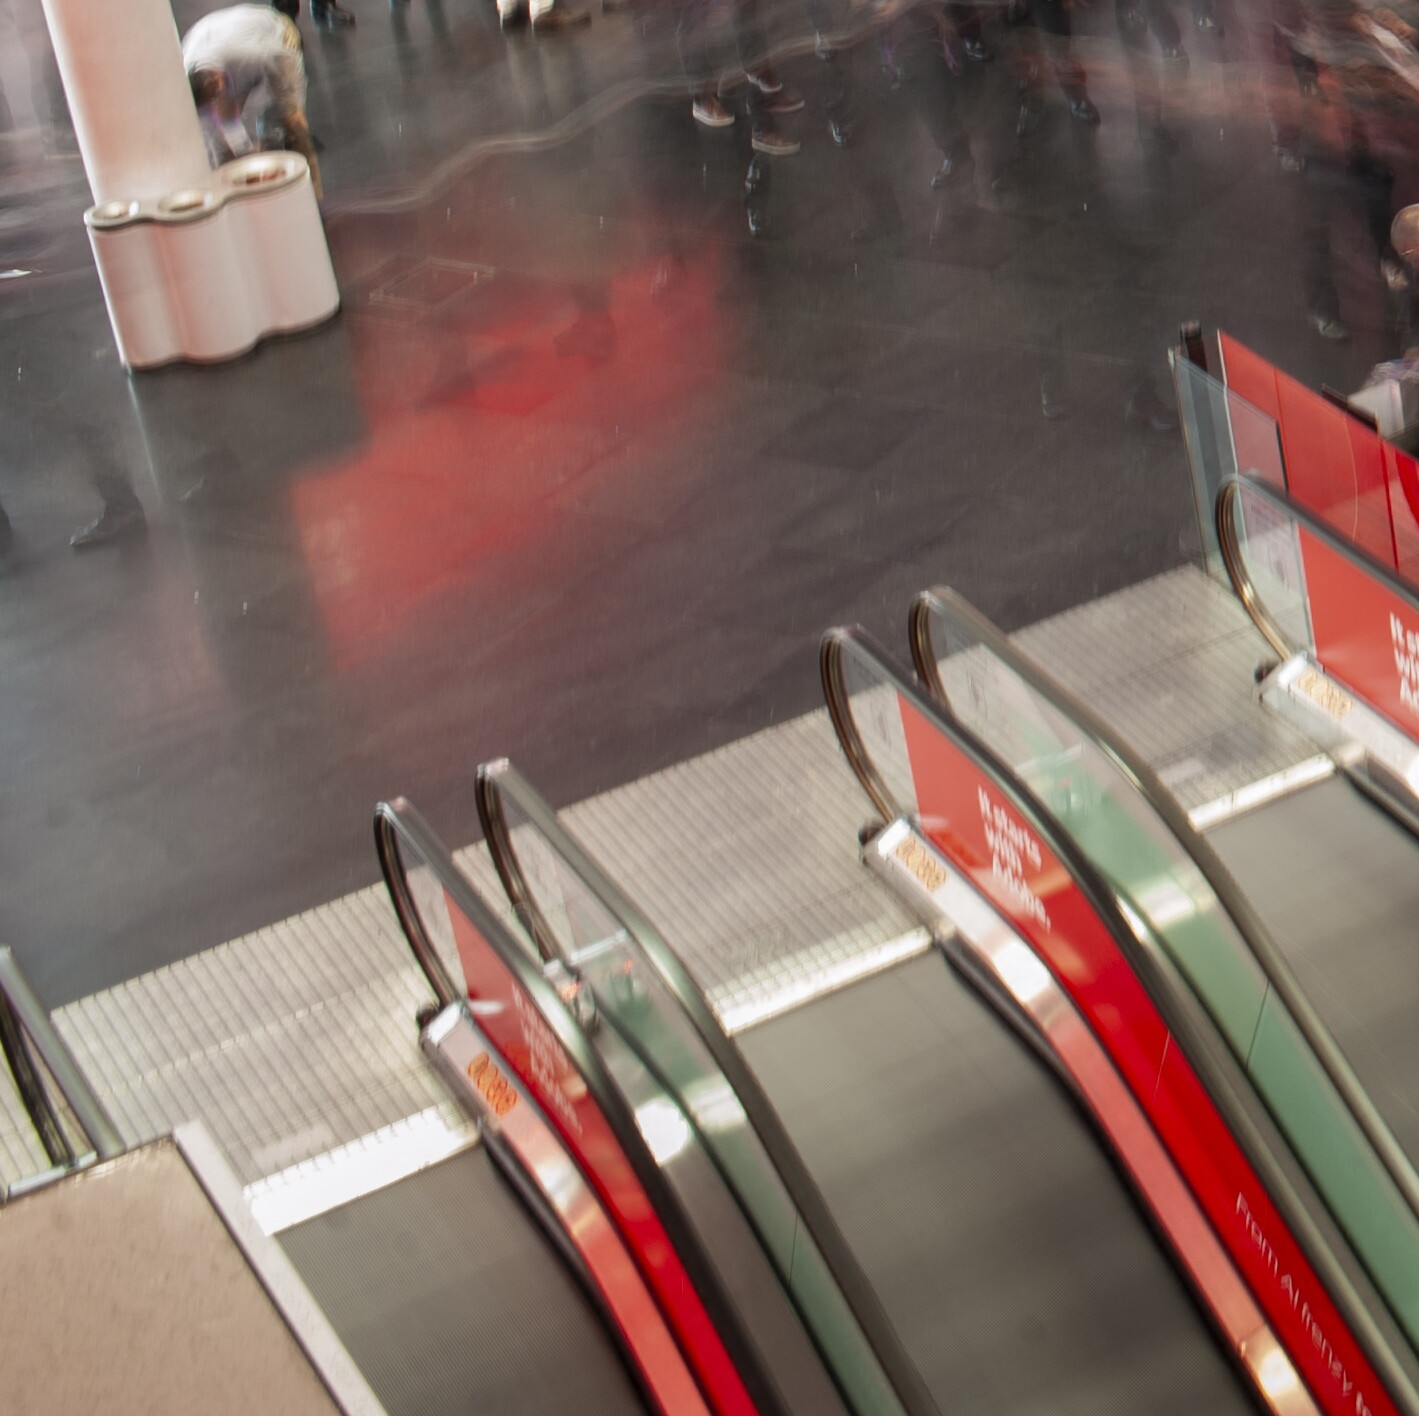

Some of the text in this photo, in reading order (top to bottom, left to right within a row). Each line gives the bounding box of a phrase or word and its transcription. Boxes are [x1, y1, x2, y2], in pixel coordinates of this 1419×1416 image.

[1390, 611, 1406, 649] It
[1236, 1191, 1279, 1278] From
[1301, 1301, 1353, 1397] frenzy
